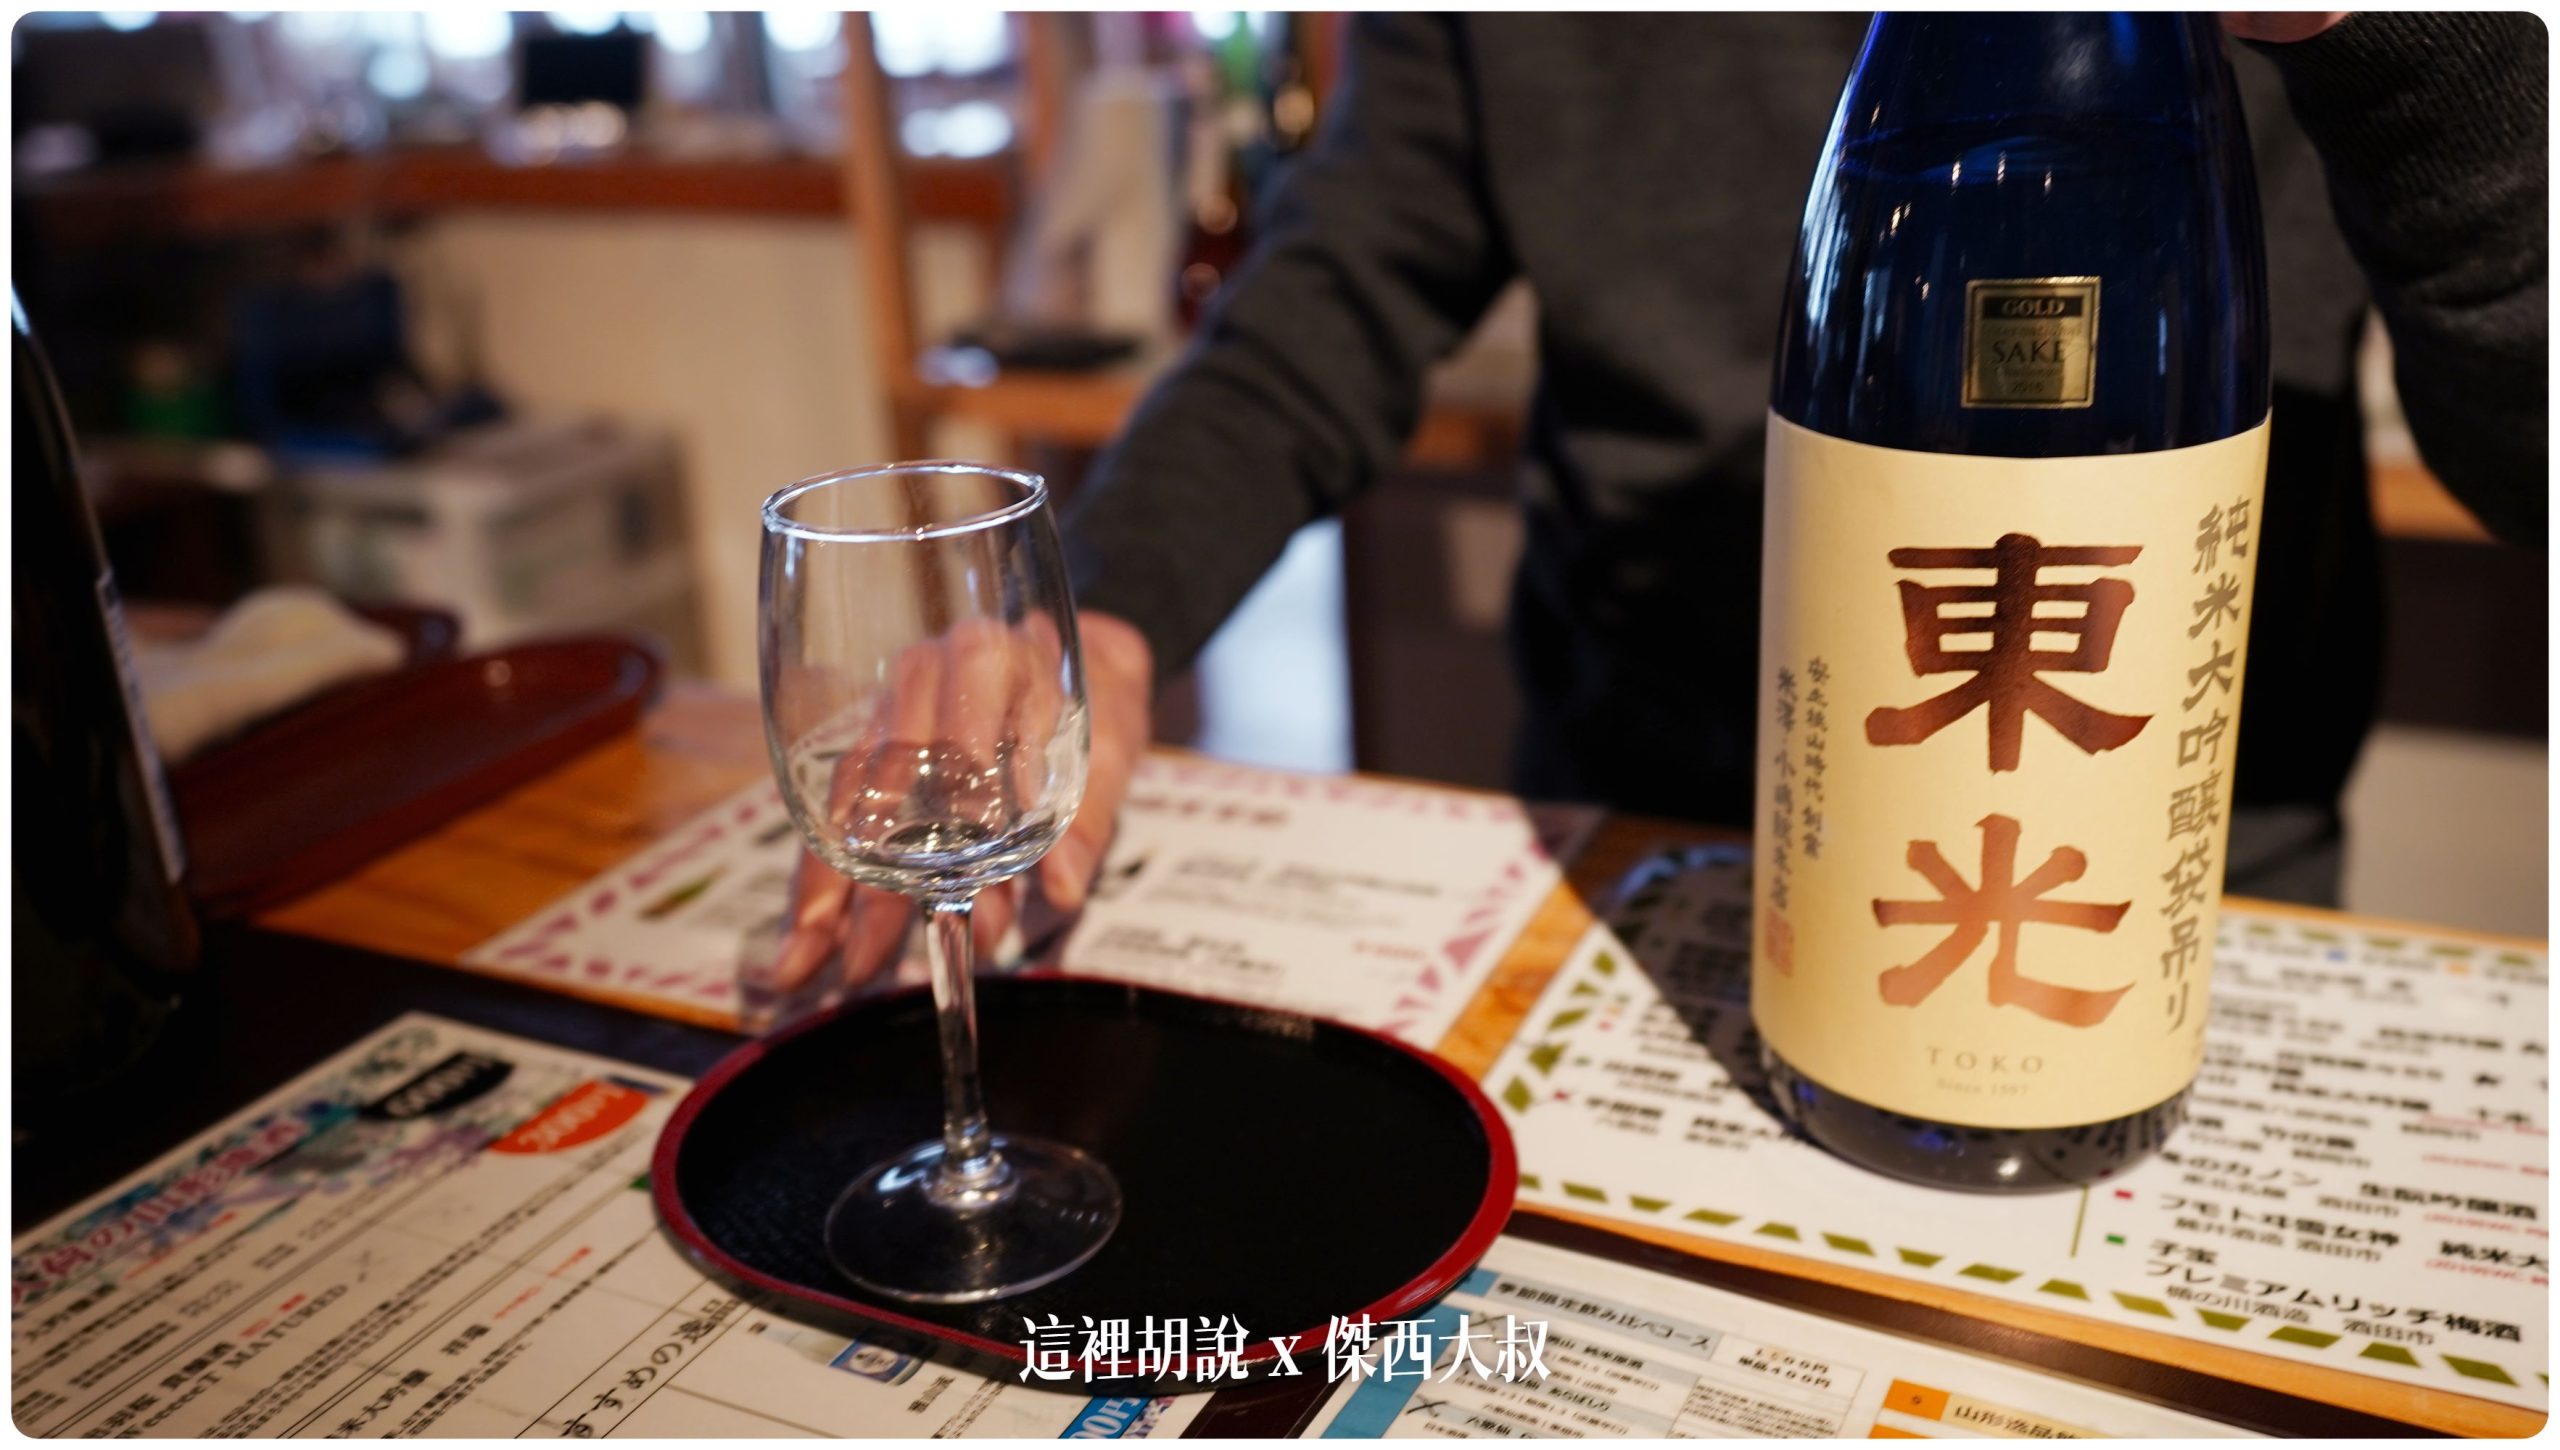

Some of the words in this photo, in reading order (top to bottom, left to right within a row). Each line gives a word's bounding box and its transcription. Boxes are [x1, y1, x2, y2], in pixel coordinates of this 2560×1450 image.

[2002, 299, 2066, 316] GOLD
[1992, 338, 2066, 363] SAKE
[1864, 532, 2155, 1029] 東光
[2160, 495, 2252, 1036] 純米大吟醸袋吊り
[1925, 1045, 2045, 1074] TOKO
[222, 1283, 350, 1370] MATURED
